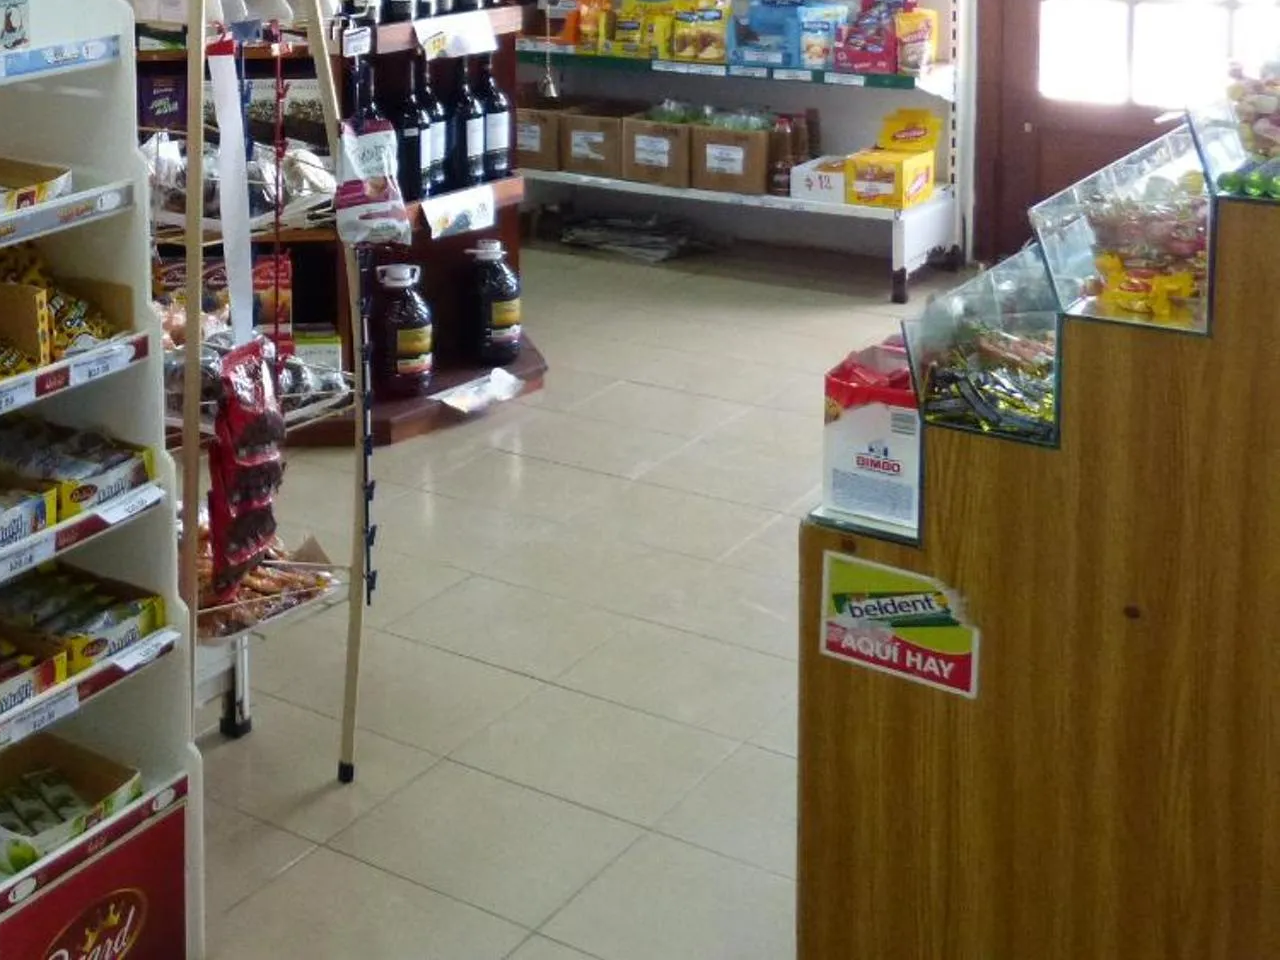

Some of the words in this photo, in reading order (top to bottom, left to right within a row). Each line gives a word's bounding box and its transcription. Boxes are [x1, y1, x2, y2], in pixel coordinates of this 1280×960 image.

[855, 455, 901, 473] BIMBO
[848, 594, 934, 618] beldent
[905, 650, 955, 679] HAY
